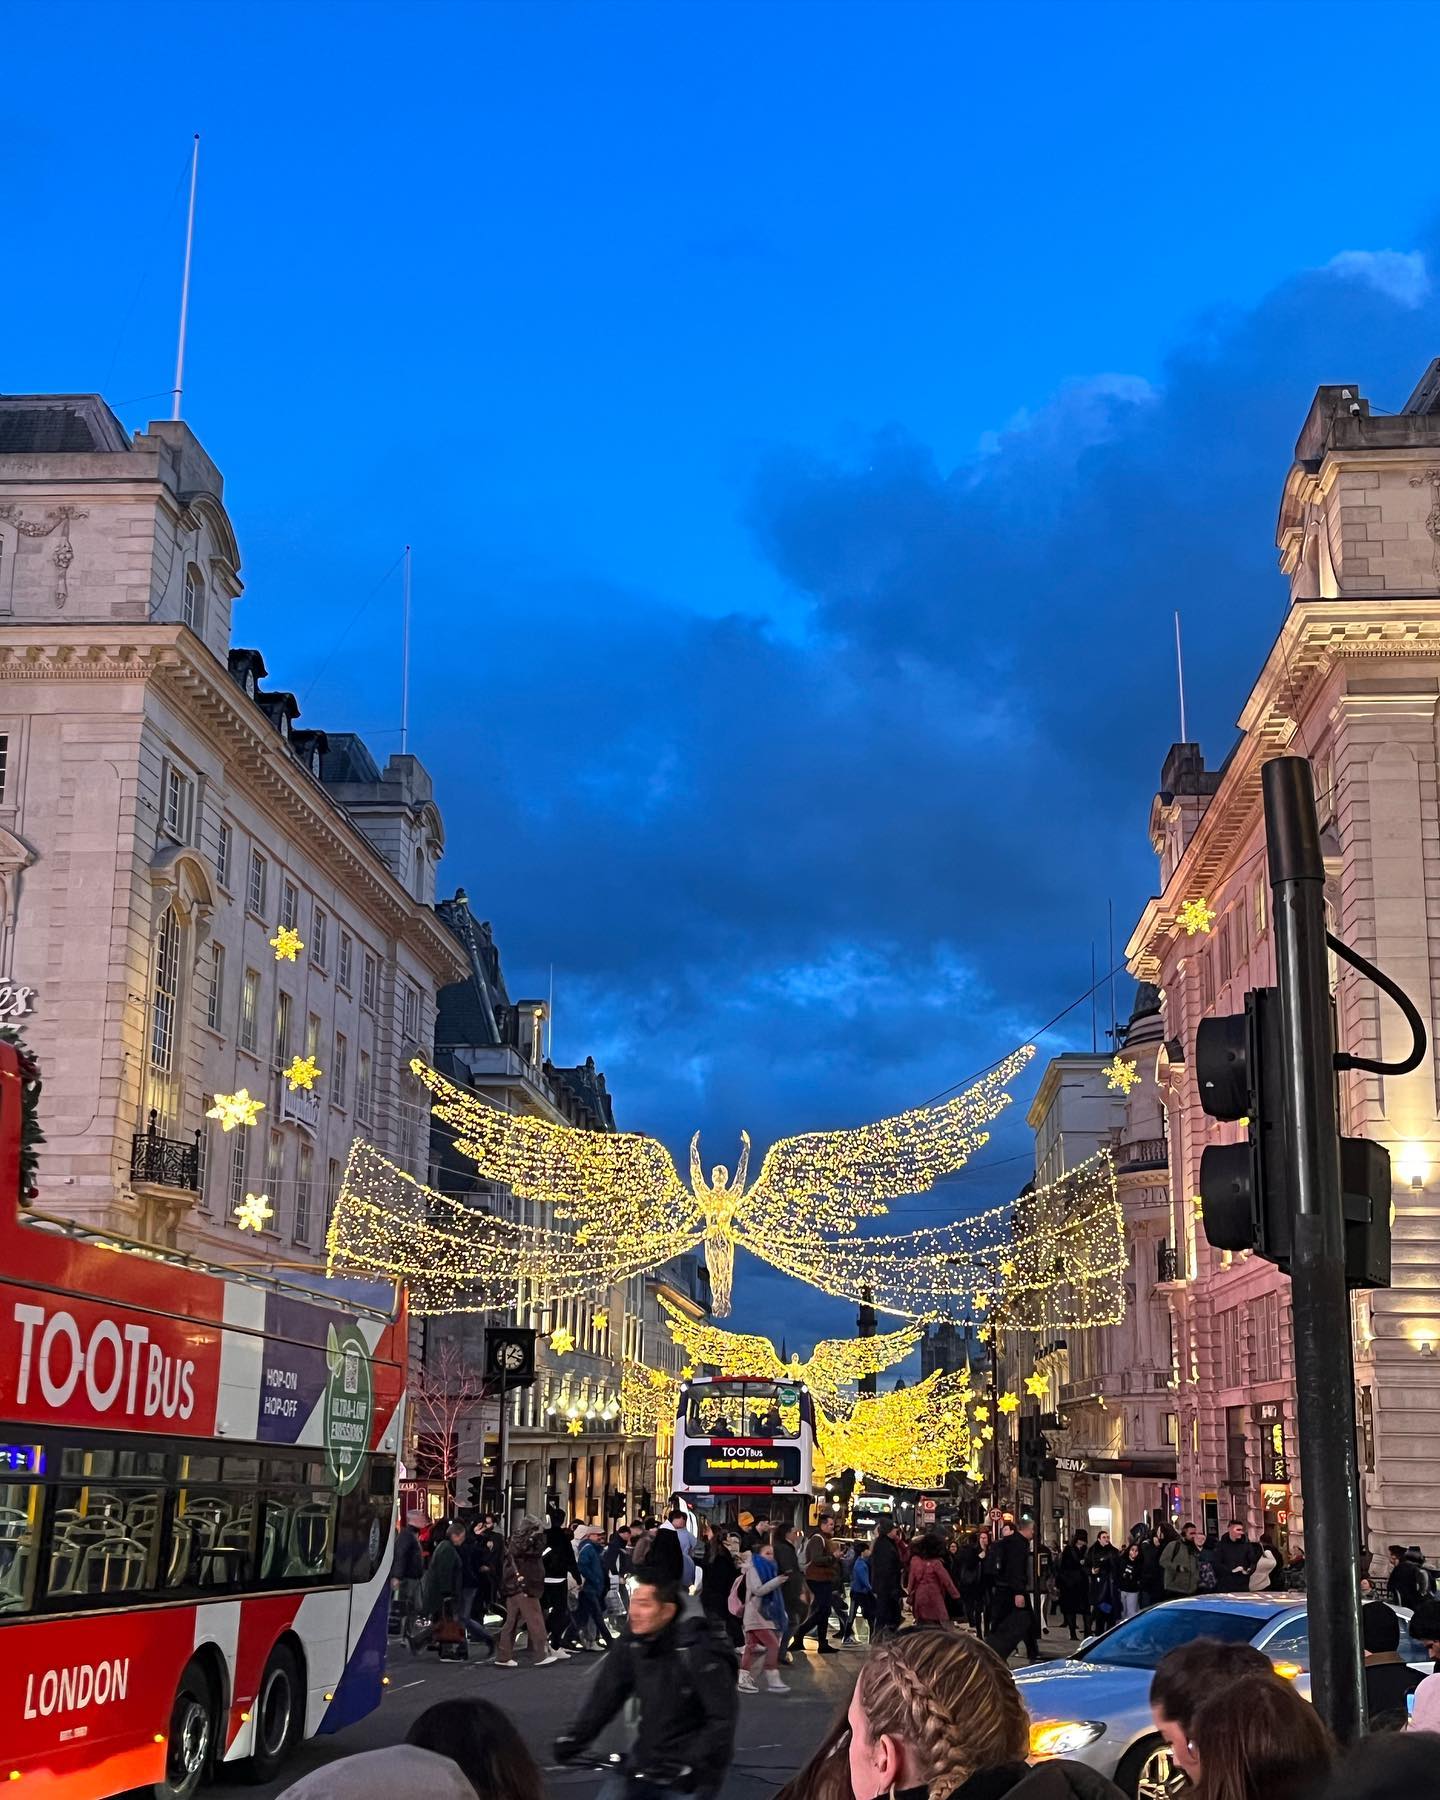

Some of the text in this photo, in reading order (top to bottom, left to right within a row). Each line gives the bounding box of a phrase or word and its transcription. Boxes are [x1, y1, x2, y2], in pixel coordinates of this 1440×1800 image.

[266, 1369, 298, 1390] HOP-ON
[264, 1396, 298, 1418] HOP-OFF
[991, 1510, 1001, 1518] 20
[24, 1658, 129, 1720] LONDON
